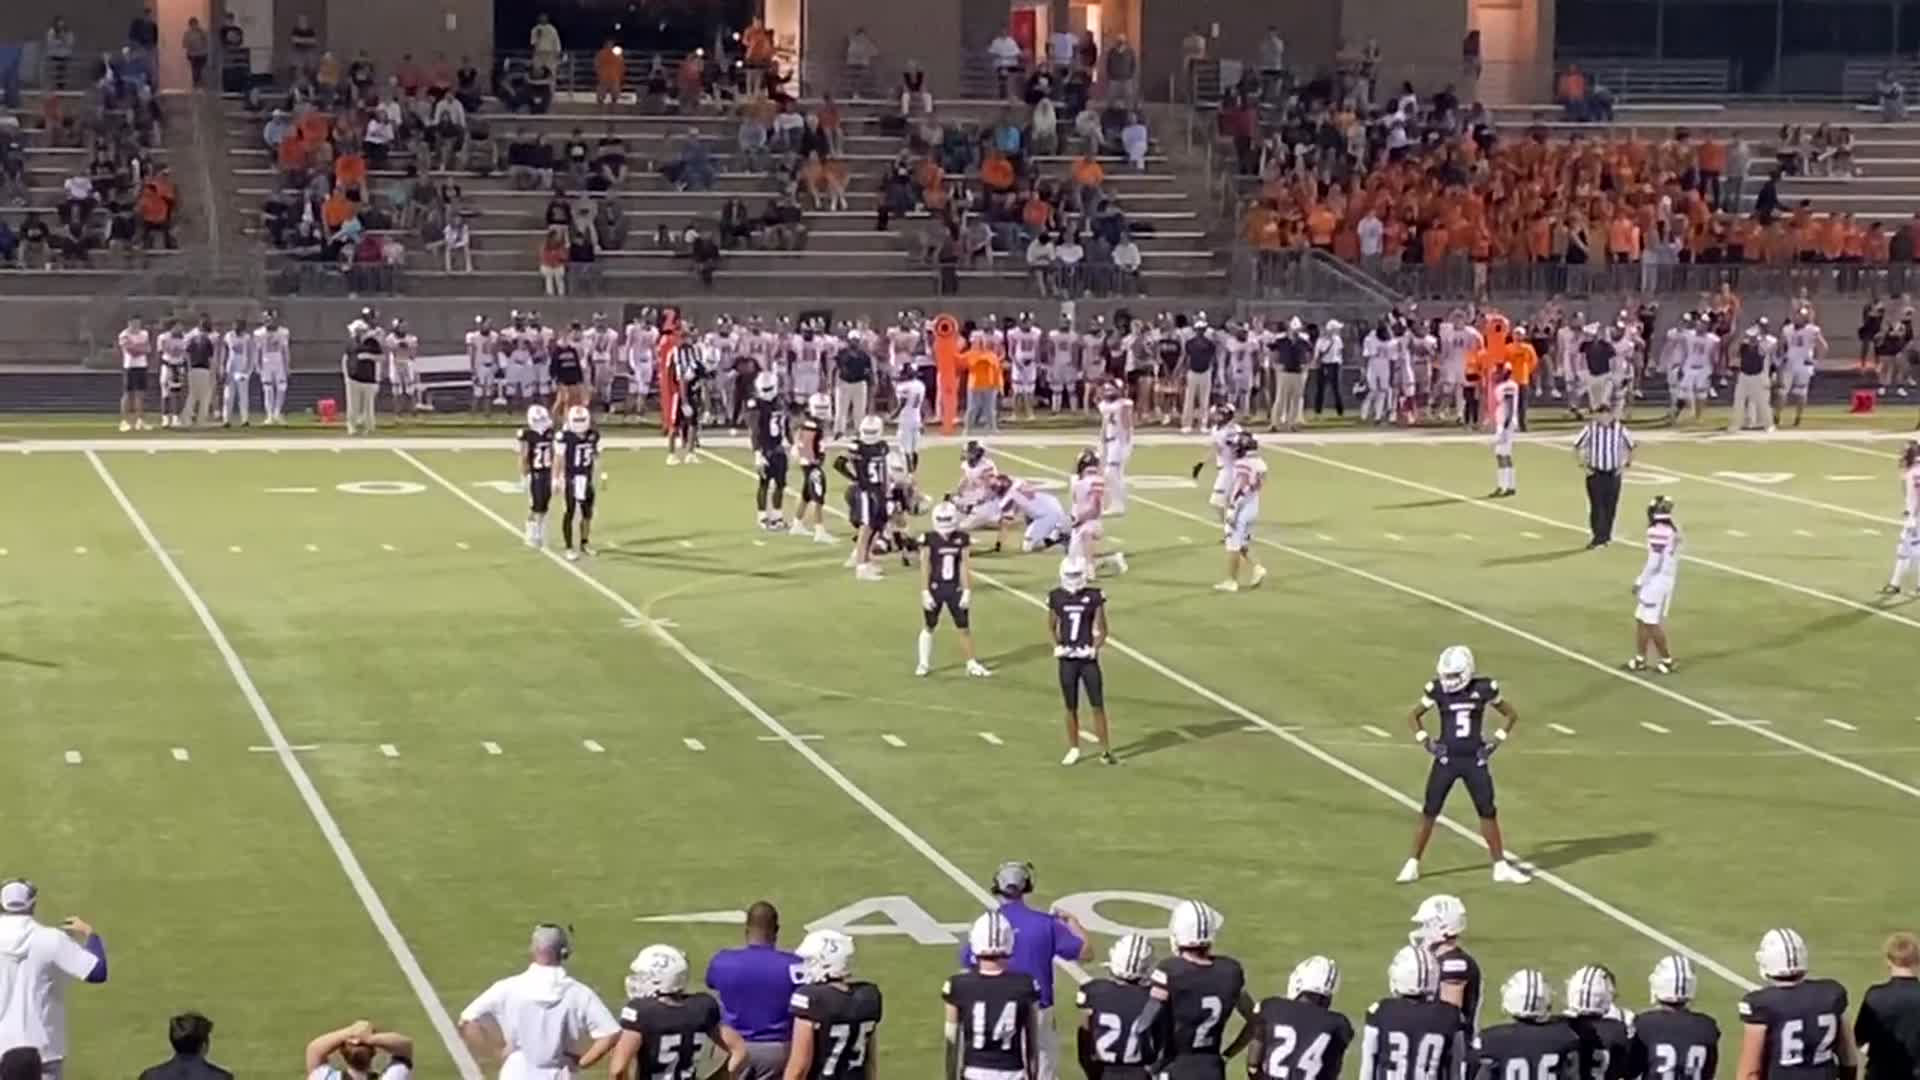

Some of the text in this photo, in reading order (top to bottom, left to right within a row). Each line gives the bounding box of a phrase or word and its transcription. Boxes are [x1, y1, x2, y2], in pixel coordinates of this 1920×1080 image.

[1069, 612, 1080, 641] 7
[1455, 710, 1471, 738] 5
[972, 1001, 1018, 1050] 14
[1192, 996, 1222, 1048] 2
[1779, 1013, 1837, 1066] 62
[822, 1021, 877, 1076] 75
[1269, 1024, 1332, 1080] 24
[1386, 1031, 1445, 1080] 30
